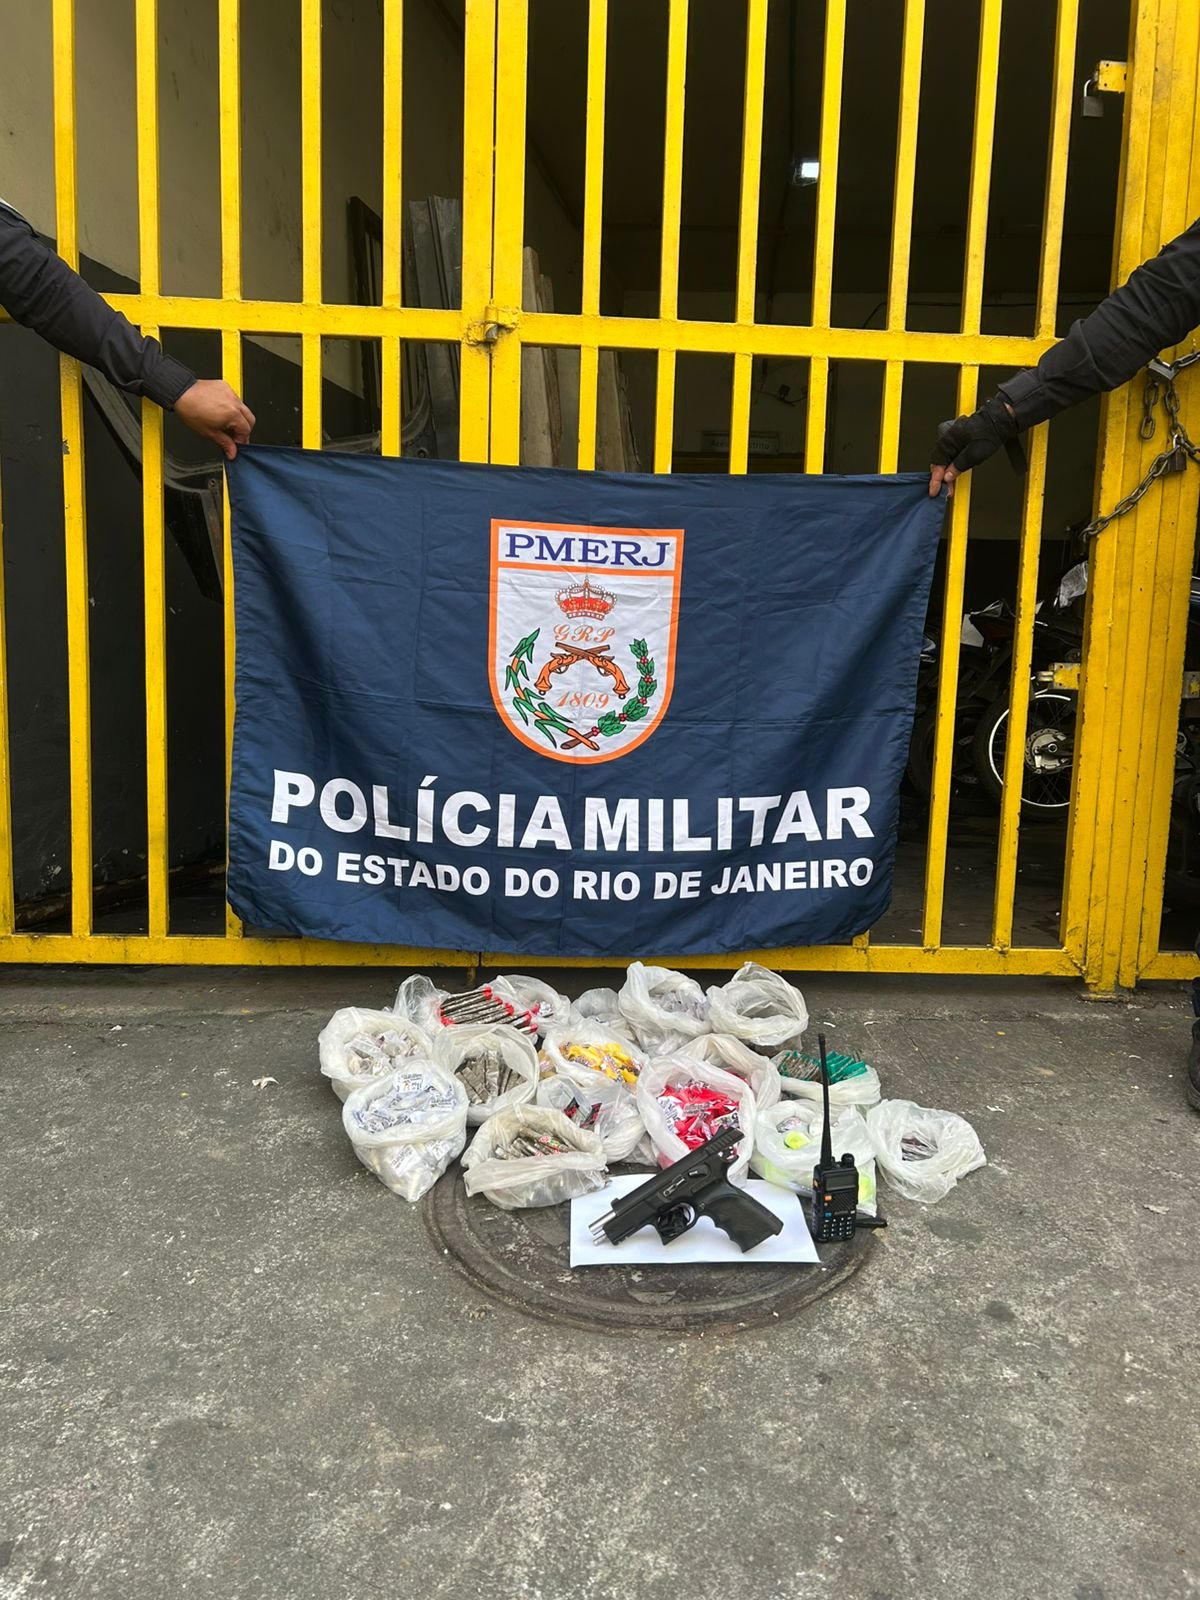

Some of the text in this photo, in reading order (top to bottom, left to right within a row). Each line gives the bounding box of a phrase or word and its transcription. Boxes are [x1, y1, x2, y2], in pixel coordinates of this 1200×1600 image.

[505, 533, 670, 567] PMERJ
[556, 691, 610, 710] 1809
[270, 768, 875, 852] POLÍCIA MILITAR
[268, 839, 875, 901] DO ESTADO DO RIO DE JANEIRO
